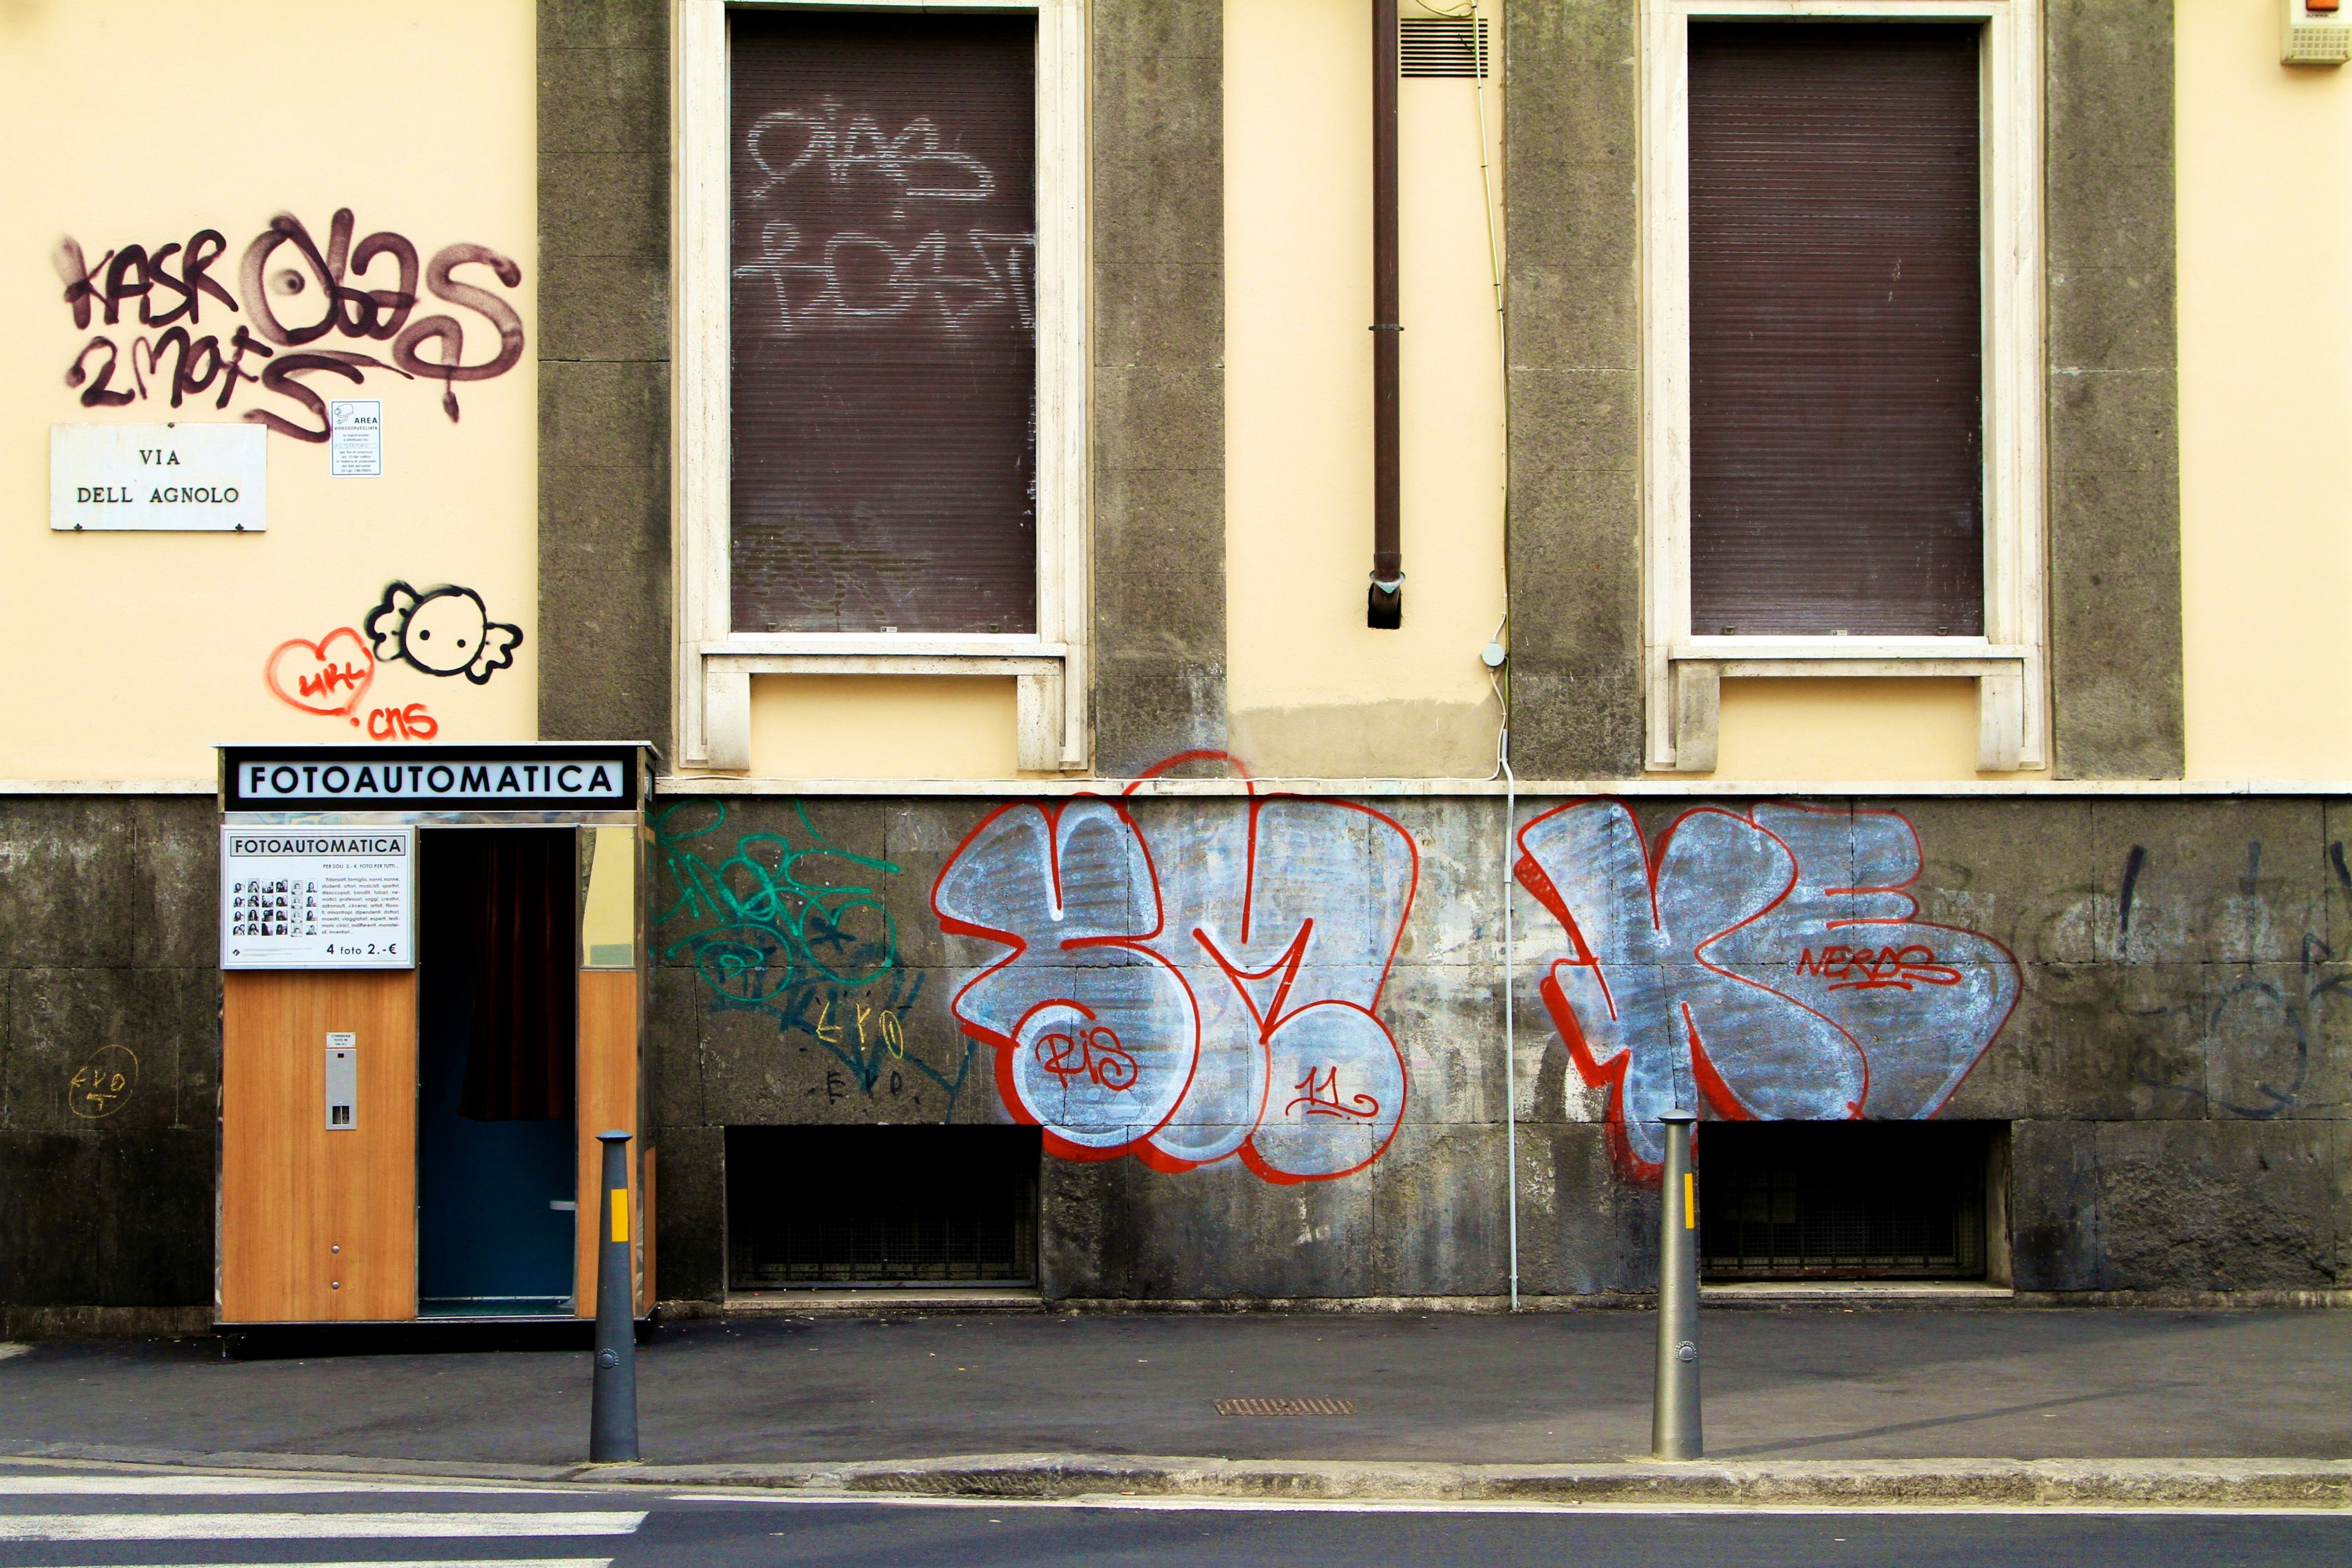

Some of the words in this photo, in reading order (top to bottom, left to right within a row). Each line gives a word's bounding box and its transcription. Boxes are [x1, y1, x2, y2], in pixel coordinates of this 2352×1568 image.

[139, 450, 181, 466] VIA
[77, 487, 134, 503] DELL
[150, 487, 239, 503] AGNOLO
[251, 766, 612, 794] FOTOAUTOMATICA
[235, 839, 401, 853] FOTOAUTOMATICA
[326, 944, 334, 955] 4
[340, 946, 362, 955] foto
